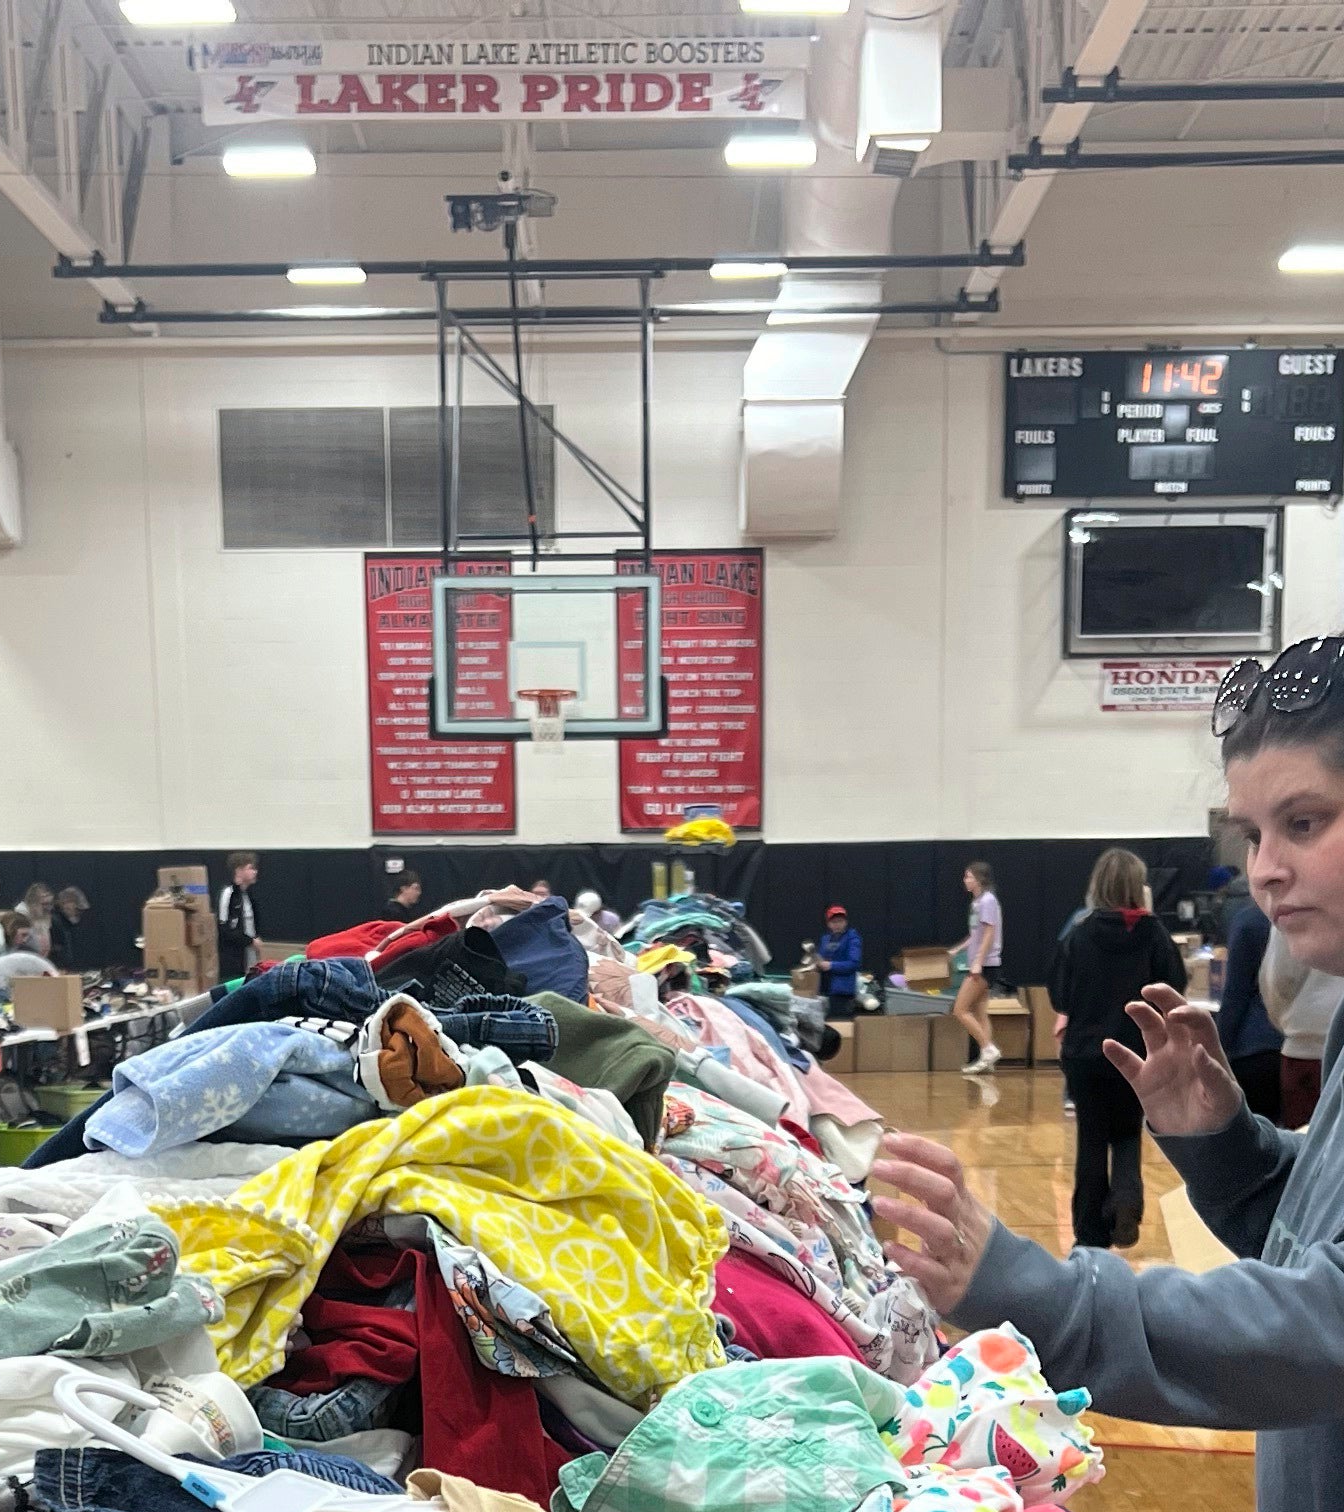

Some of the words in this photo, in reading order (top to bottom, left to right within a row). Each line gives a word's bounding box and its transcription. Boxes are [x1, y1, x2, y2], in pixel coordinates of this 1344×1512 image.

[368, 43, 456, 66] INDIAN
[462, 43, 519, 65] LAKE
[527, 43, 638, 65] ATHLETIC
[645, 41, 764, 65] BOOSTERS
[295, 74, 501, 114] LAKER
[521, 73, 712, 112] PRIDE
[1010, 357, 1084, 377] LAKERS
[1278, 355, 1336, 375] GUEST
[1142, 361, 1224, 395] 11:42
[1015, 430, 1055, 444] FOULS
[1117, 429, 1165, 443] PLAYER
[1186, 429, 1219, 443] FOUL
[1294, 426, 1336, 441] FOULS
[701, 562, 759, 596] LAKE
[378, 612, 433, 628] ALMA
[1111, 670, 1222, 685] HONDA
[1158, 686, 1191, 695] STATE
